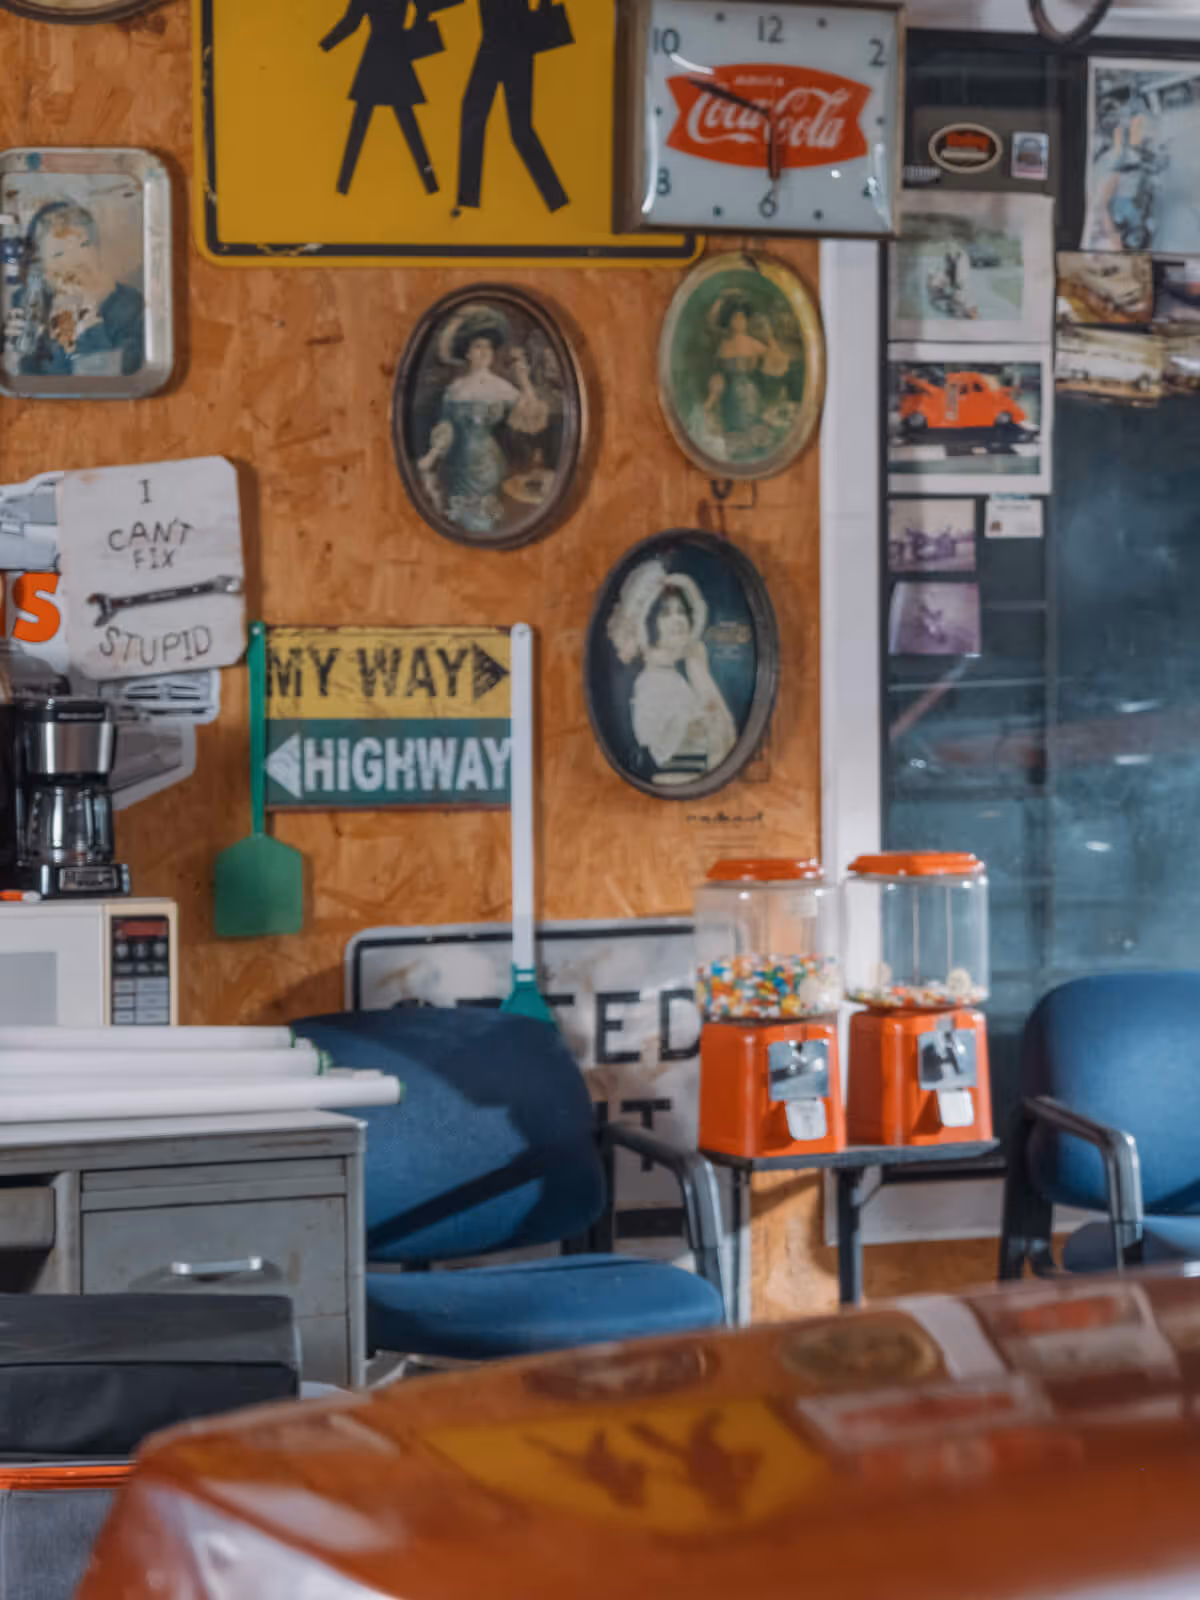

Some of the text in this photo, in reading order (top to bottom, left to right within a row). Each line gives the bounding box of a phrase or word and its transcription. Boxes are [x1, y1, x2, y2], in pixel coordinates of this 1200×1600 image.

[653, 28, 680, 55] 10
[757, 15, 784, 43] 12
[869, 38, 885, 67] 2
[758, 189, 777, 218] 6
[138, 479, 152, 504] I
[108, 516, 193, 551] CAN'T
[132, 549, 176, 570] FIX
[1, 572, 61, 643] S
[100, 625, 213, 666] STUPID
[267, 646, 470, 697] MY WAY
[304, 737, 513, 791] HIGHWAY
